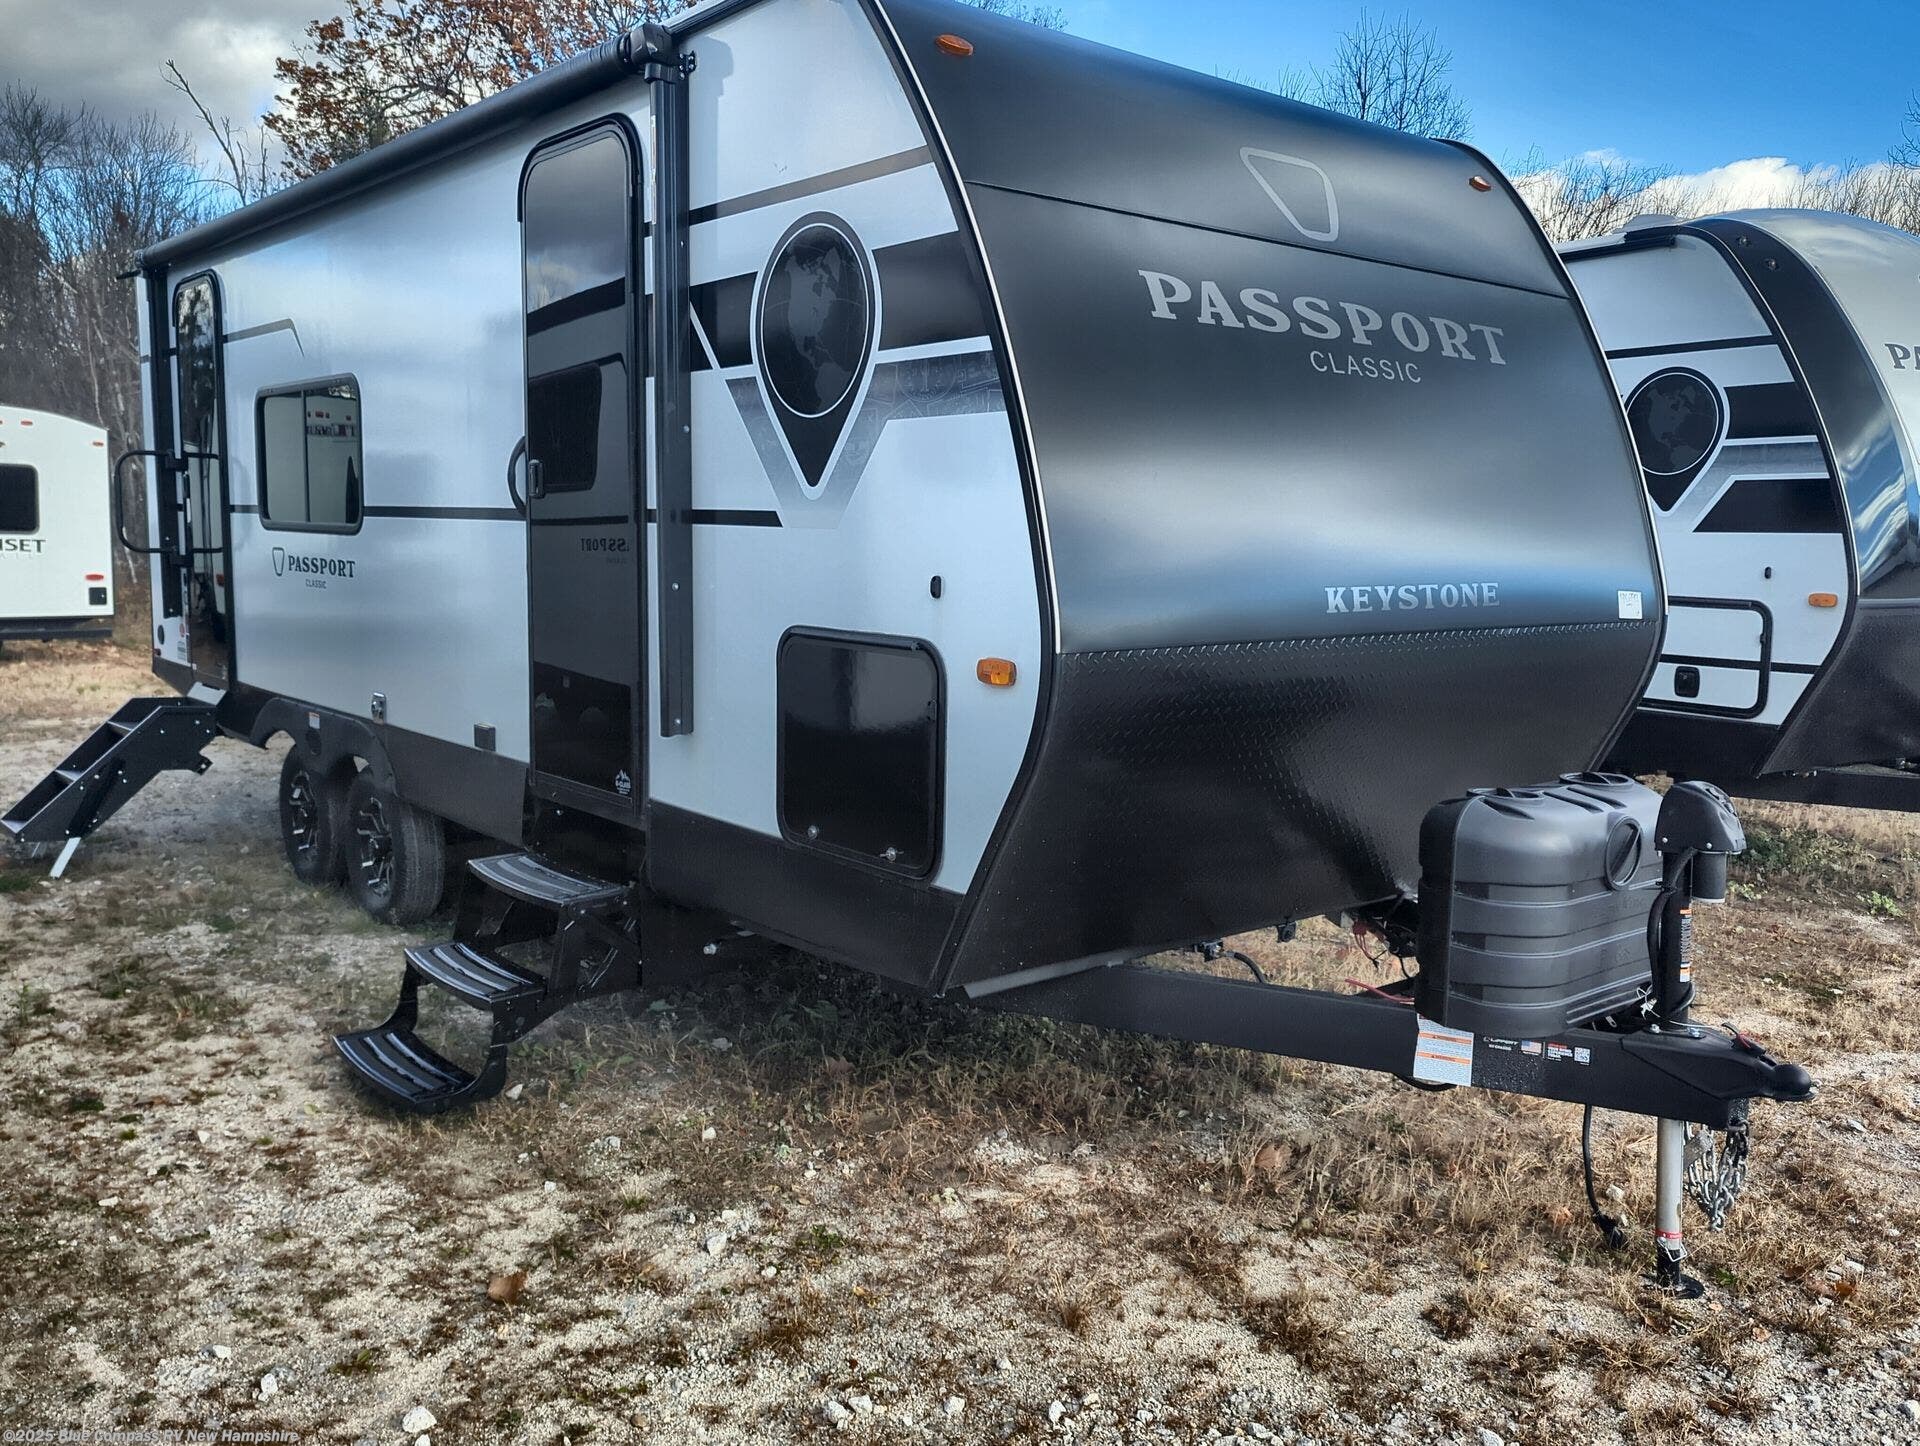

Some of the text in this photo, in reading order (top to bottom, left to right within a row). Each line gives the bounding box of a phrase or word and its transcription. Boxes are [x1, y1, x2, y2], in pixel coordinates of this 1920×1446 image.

[1138, 269, 1506, 366] PASSPORT
[1310, 350, 1422, 383] CLASSIC
[288, 555, 355, 578] PASSPORT
[1324, 582, 1500, 614] KEYSTONE
